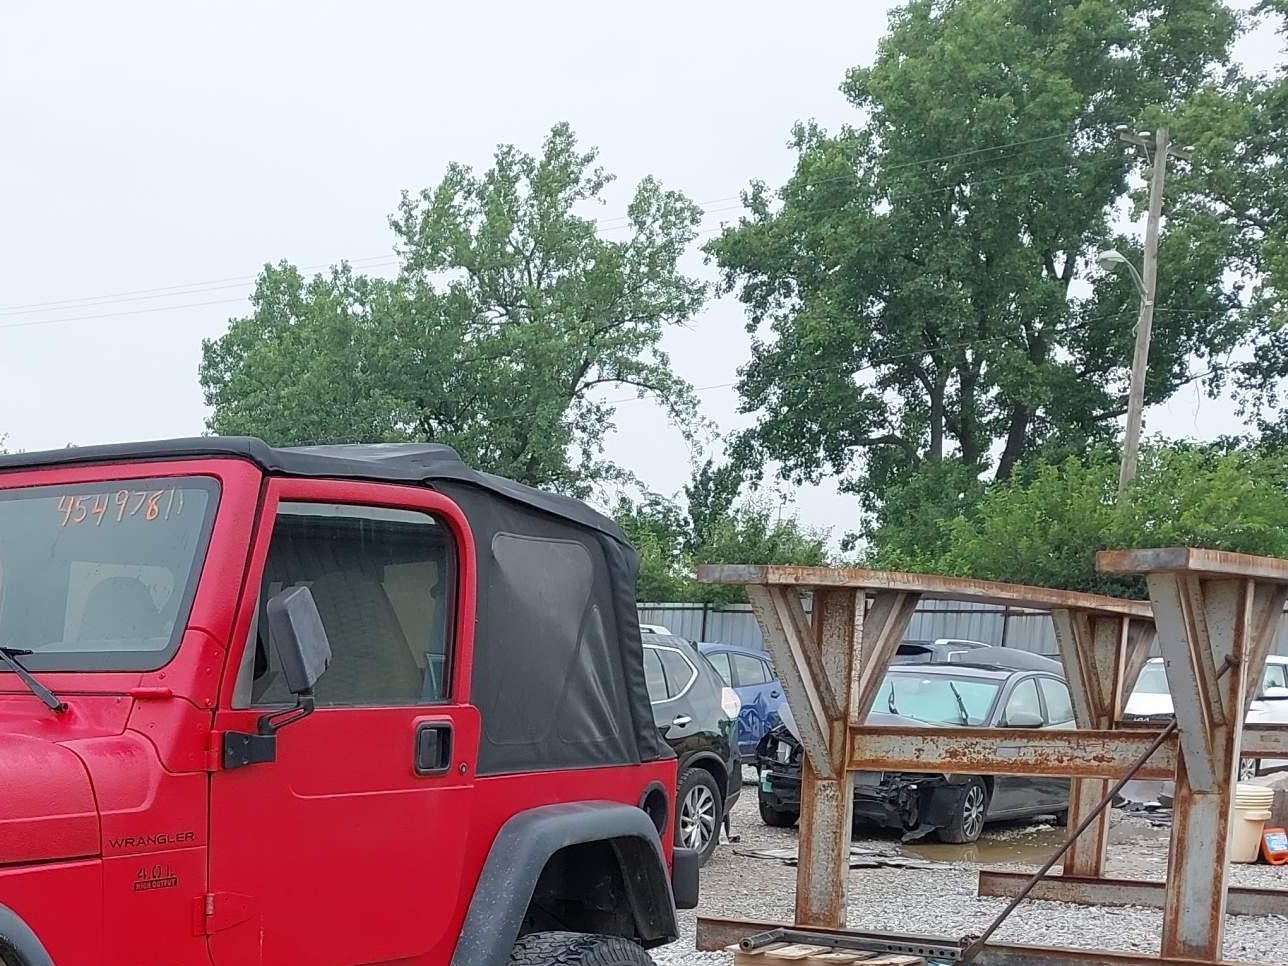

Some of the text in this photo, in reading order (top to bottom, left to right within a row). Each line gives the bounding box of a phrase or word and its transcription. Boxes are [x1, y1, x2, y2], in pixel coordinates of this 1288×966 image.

[56, 487, 184, 527] 45497811
[108, 831, 195, 849] WRANGLER
[151, 878, 177, 888] OUTPUT
